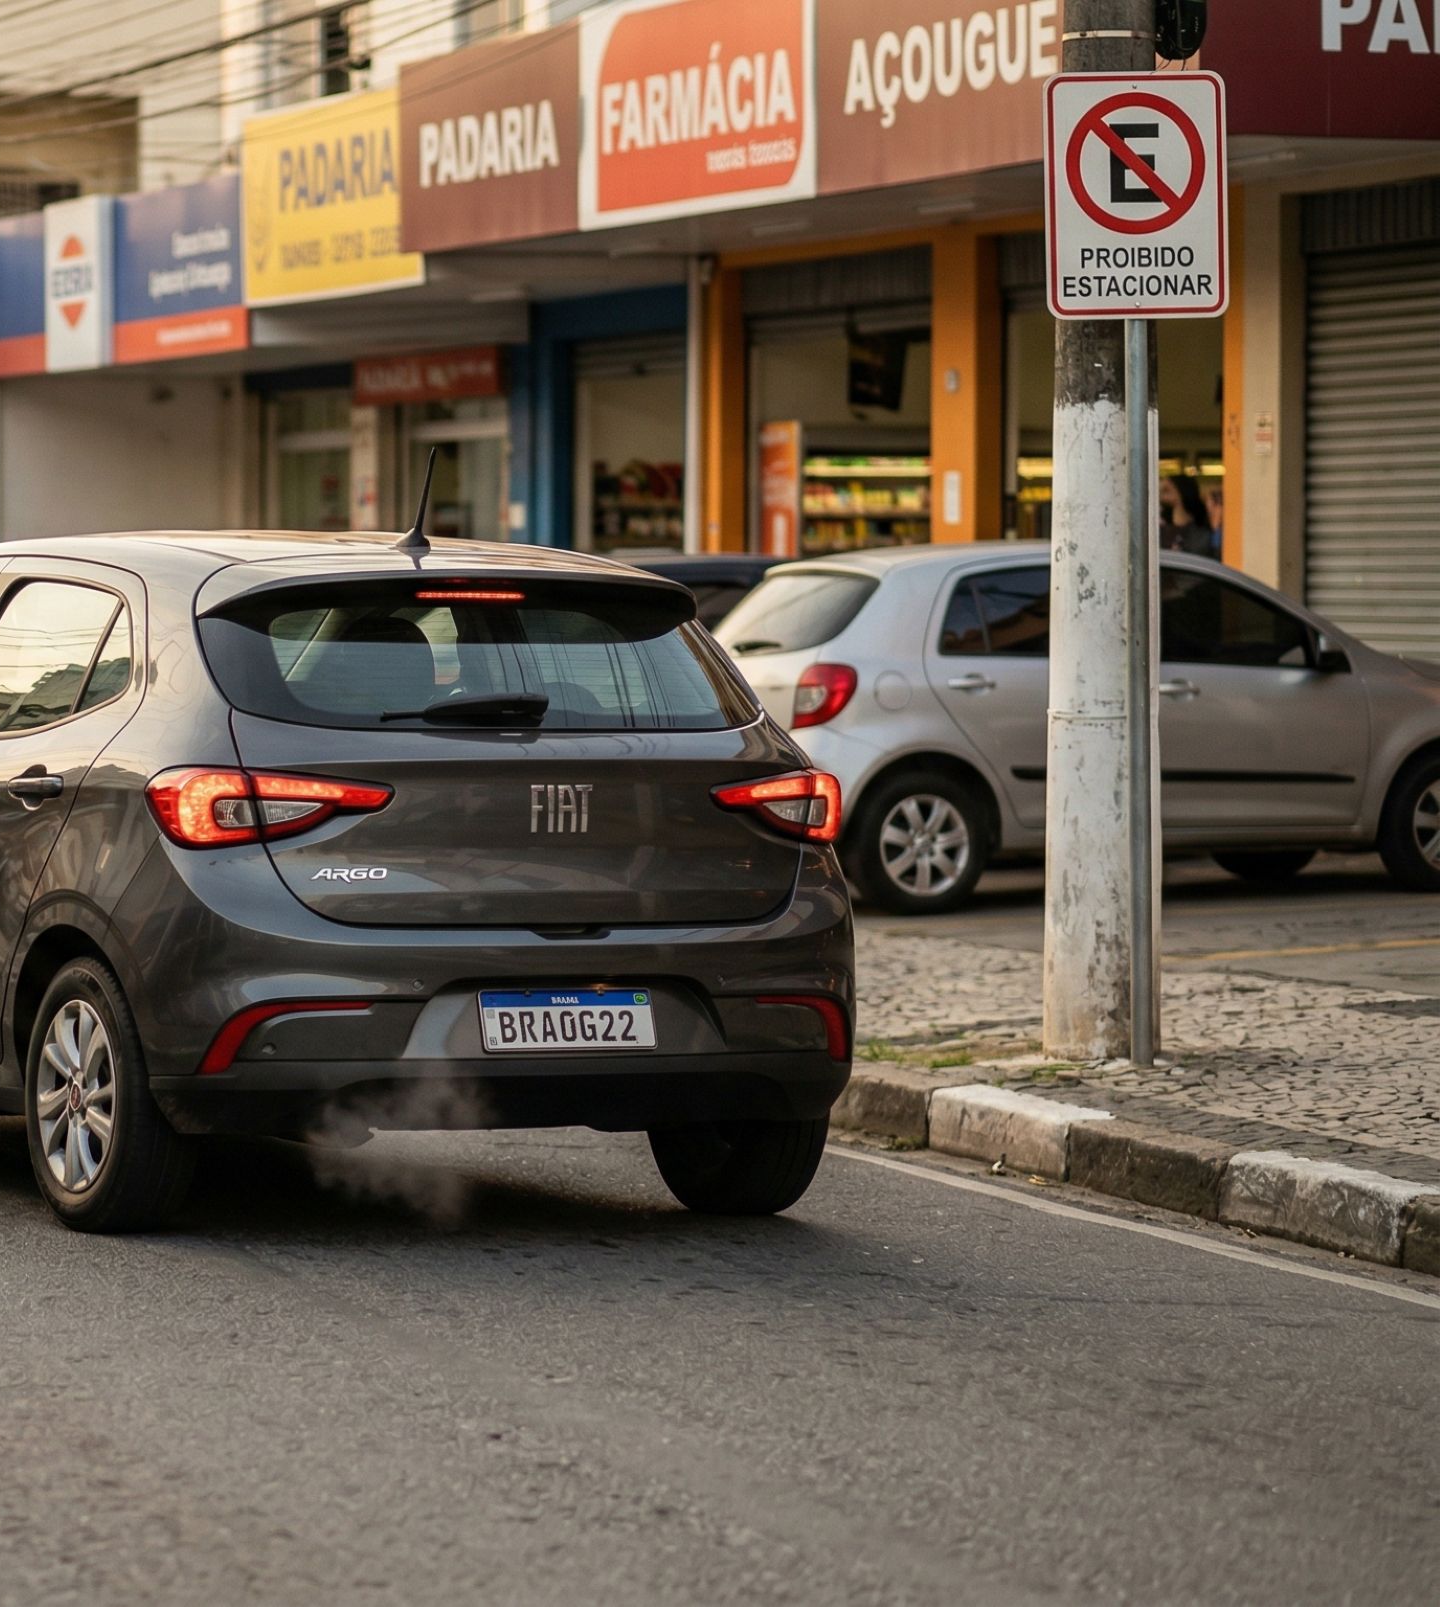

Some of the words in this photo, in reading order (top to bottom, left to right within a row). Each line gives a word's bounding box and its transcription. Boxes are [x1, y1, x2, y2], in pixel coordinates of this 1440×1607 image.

[1321, 0, 1440, 54] PA
[602, 40, 797, 156] FARMÁCIA
[844, 0, 1059, 129] AÇOUGUE
[278, 127, 400, 214] PADARIA
[418, 99, 560, 189] PADARIA
[1109, 123, 1163, 203] E
[1062, 274, 1213, 297] ESTACIONAR
[1080, 246, 1195, 269] PROIBIDO
[530, 784, 593, 833] FIAT
[310, 867, 388, 884] ARGO
